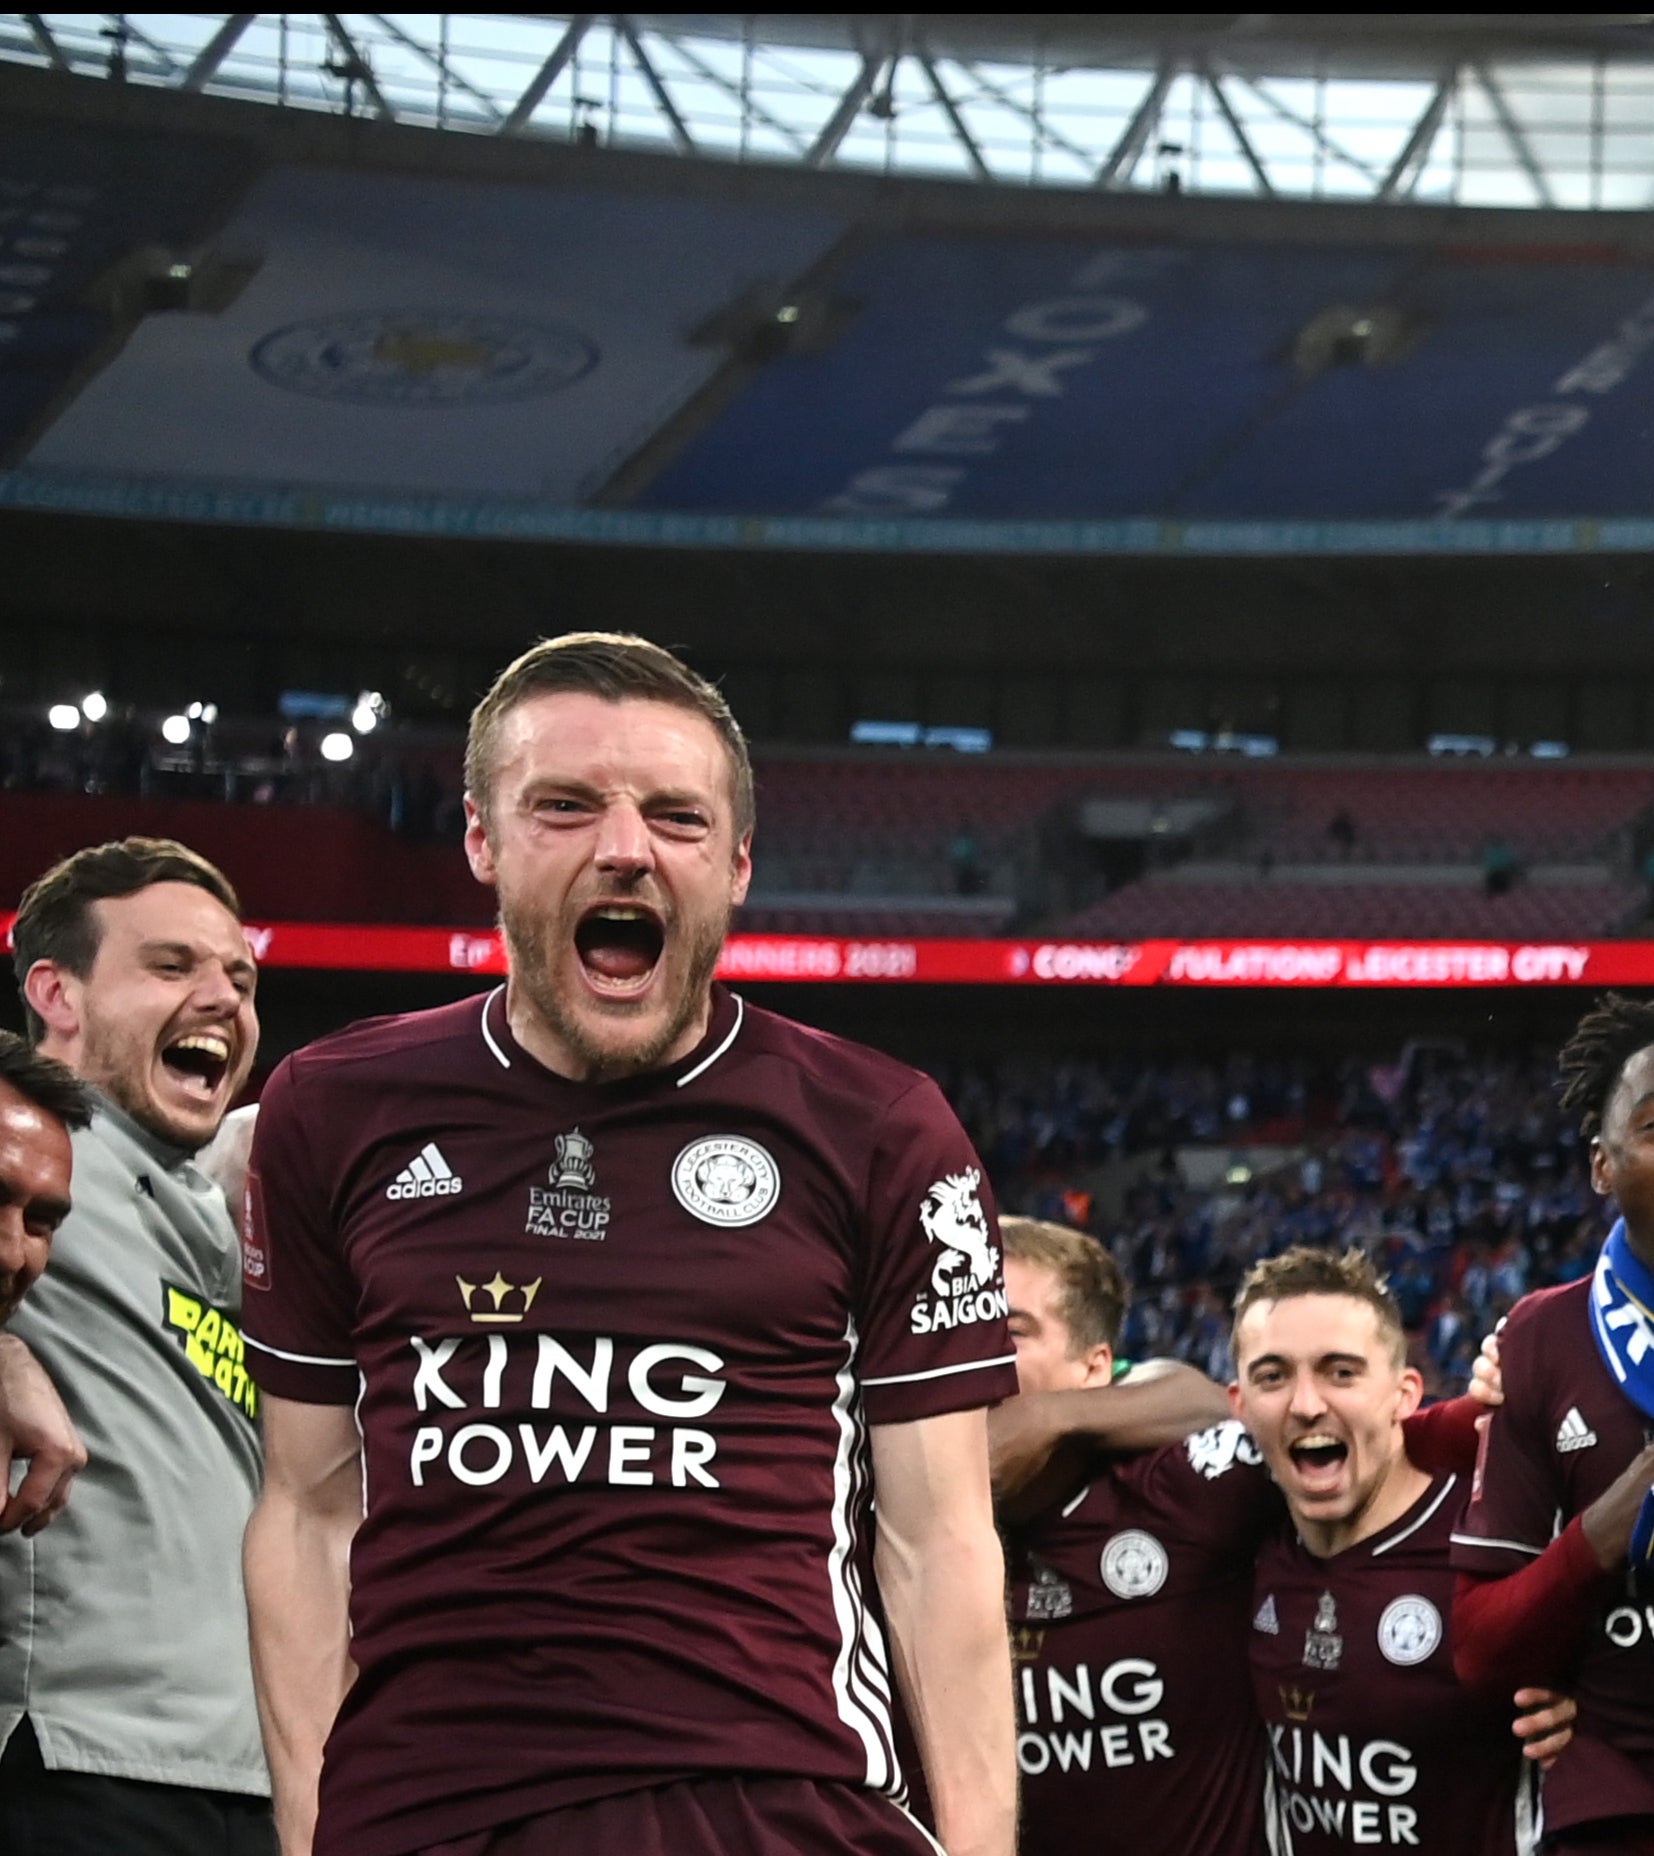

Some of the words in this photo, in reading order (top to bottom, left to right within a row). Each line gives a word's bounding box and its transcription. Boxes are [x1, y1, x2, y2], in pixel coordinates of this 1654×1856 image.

[1346, 945, 1509, 981] LEICESTER
[1511, 945, 1590, 981] CITY
[683, 1143, 749, 1173] LEICESTER
[749, 1152, 769, 1181] CITY
[386, 1177, 462, 1200] adidas
[528, 1186, 611, 1213] Emirates
[681, 1179, 742, 1218] FOOTBALL
[742, 1185, 769, 1214] CLUB
[525, 1222, 568, 1239] FINAL
[573, 1229, 607, 1242] 2021
[528, 1206, 555, 1226] FA
[560, 1209, 611, 1231] CUP
[952, 1273, 979, 1297] BIA
[910, 1288, 1009, 1335] SAIGON
[410, 1334, 727, 1419] KING
[410, 1423, 721, 1488] POWER
[1021, 1659, 1164, 1723] ING
[1018, 1719, 1175, 1775] OWER
